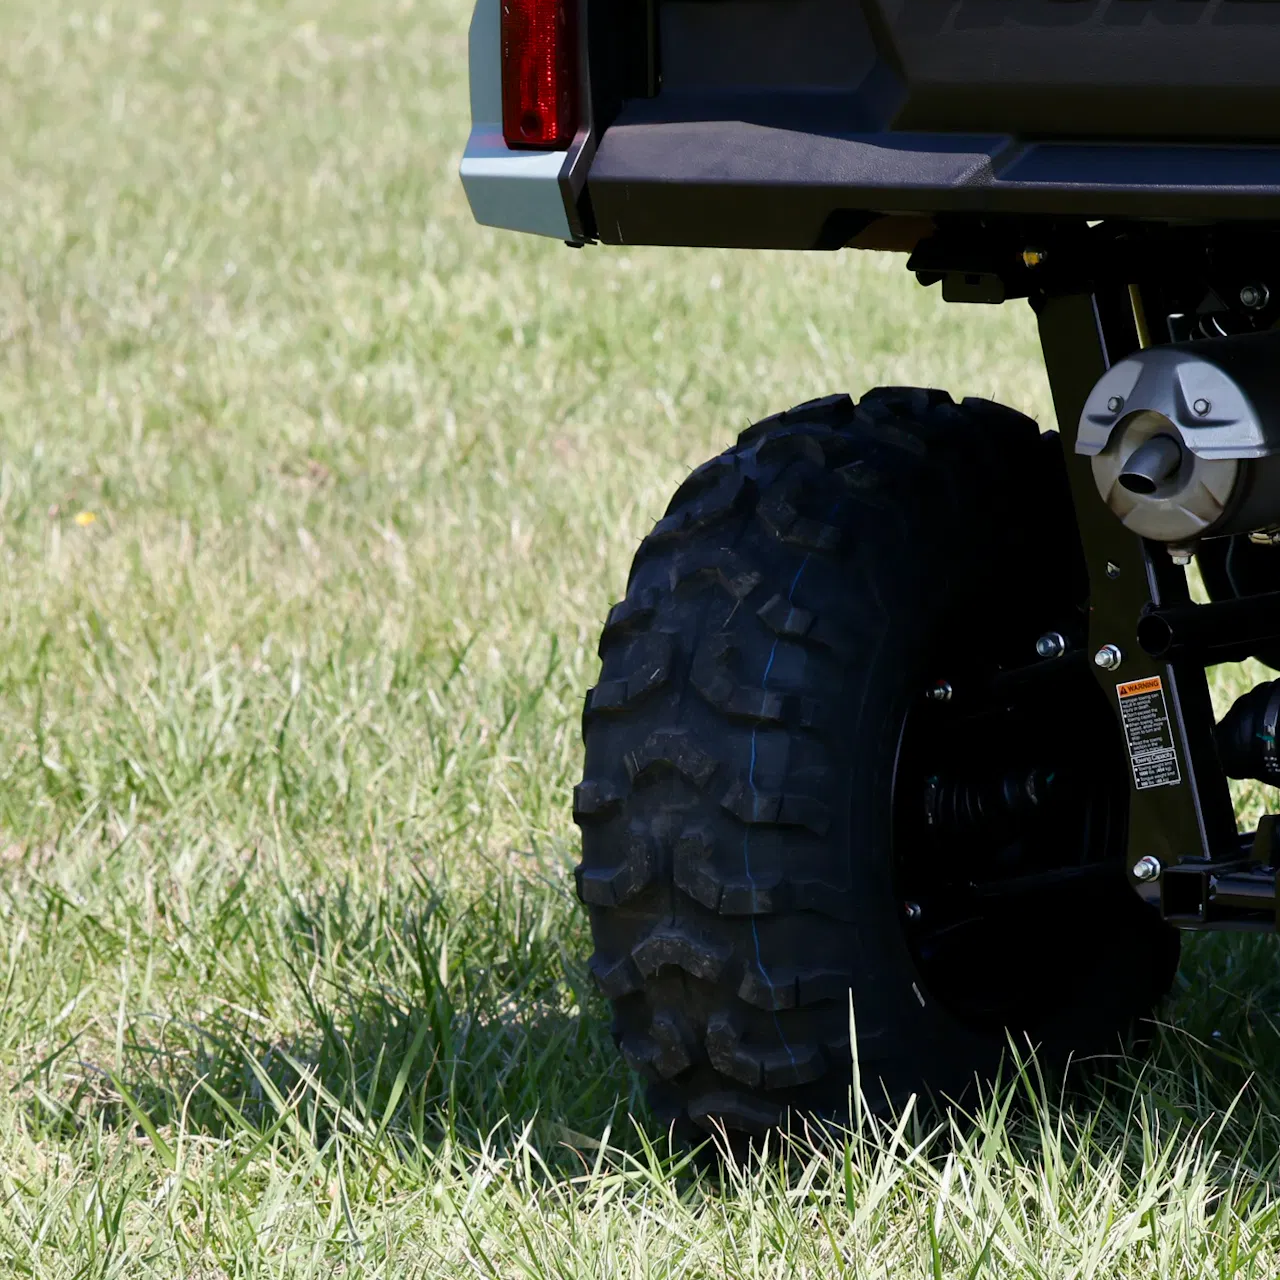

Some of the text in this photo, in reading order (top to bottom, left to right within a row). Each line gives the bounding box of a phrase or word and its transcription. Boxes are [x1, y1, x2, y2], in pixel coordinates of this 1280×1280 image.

[1128, 680, 1159, 692] WARNING
[1134, 751, 1173, 765] Towing Capacity
